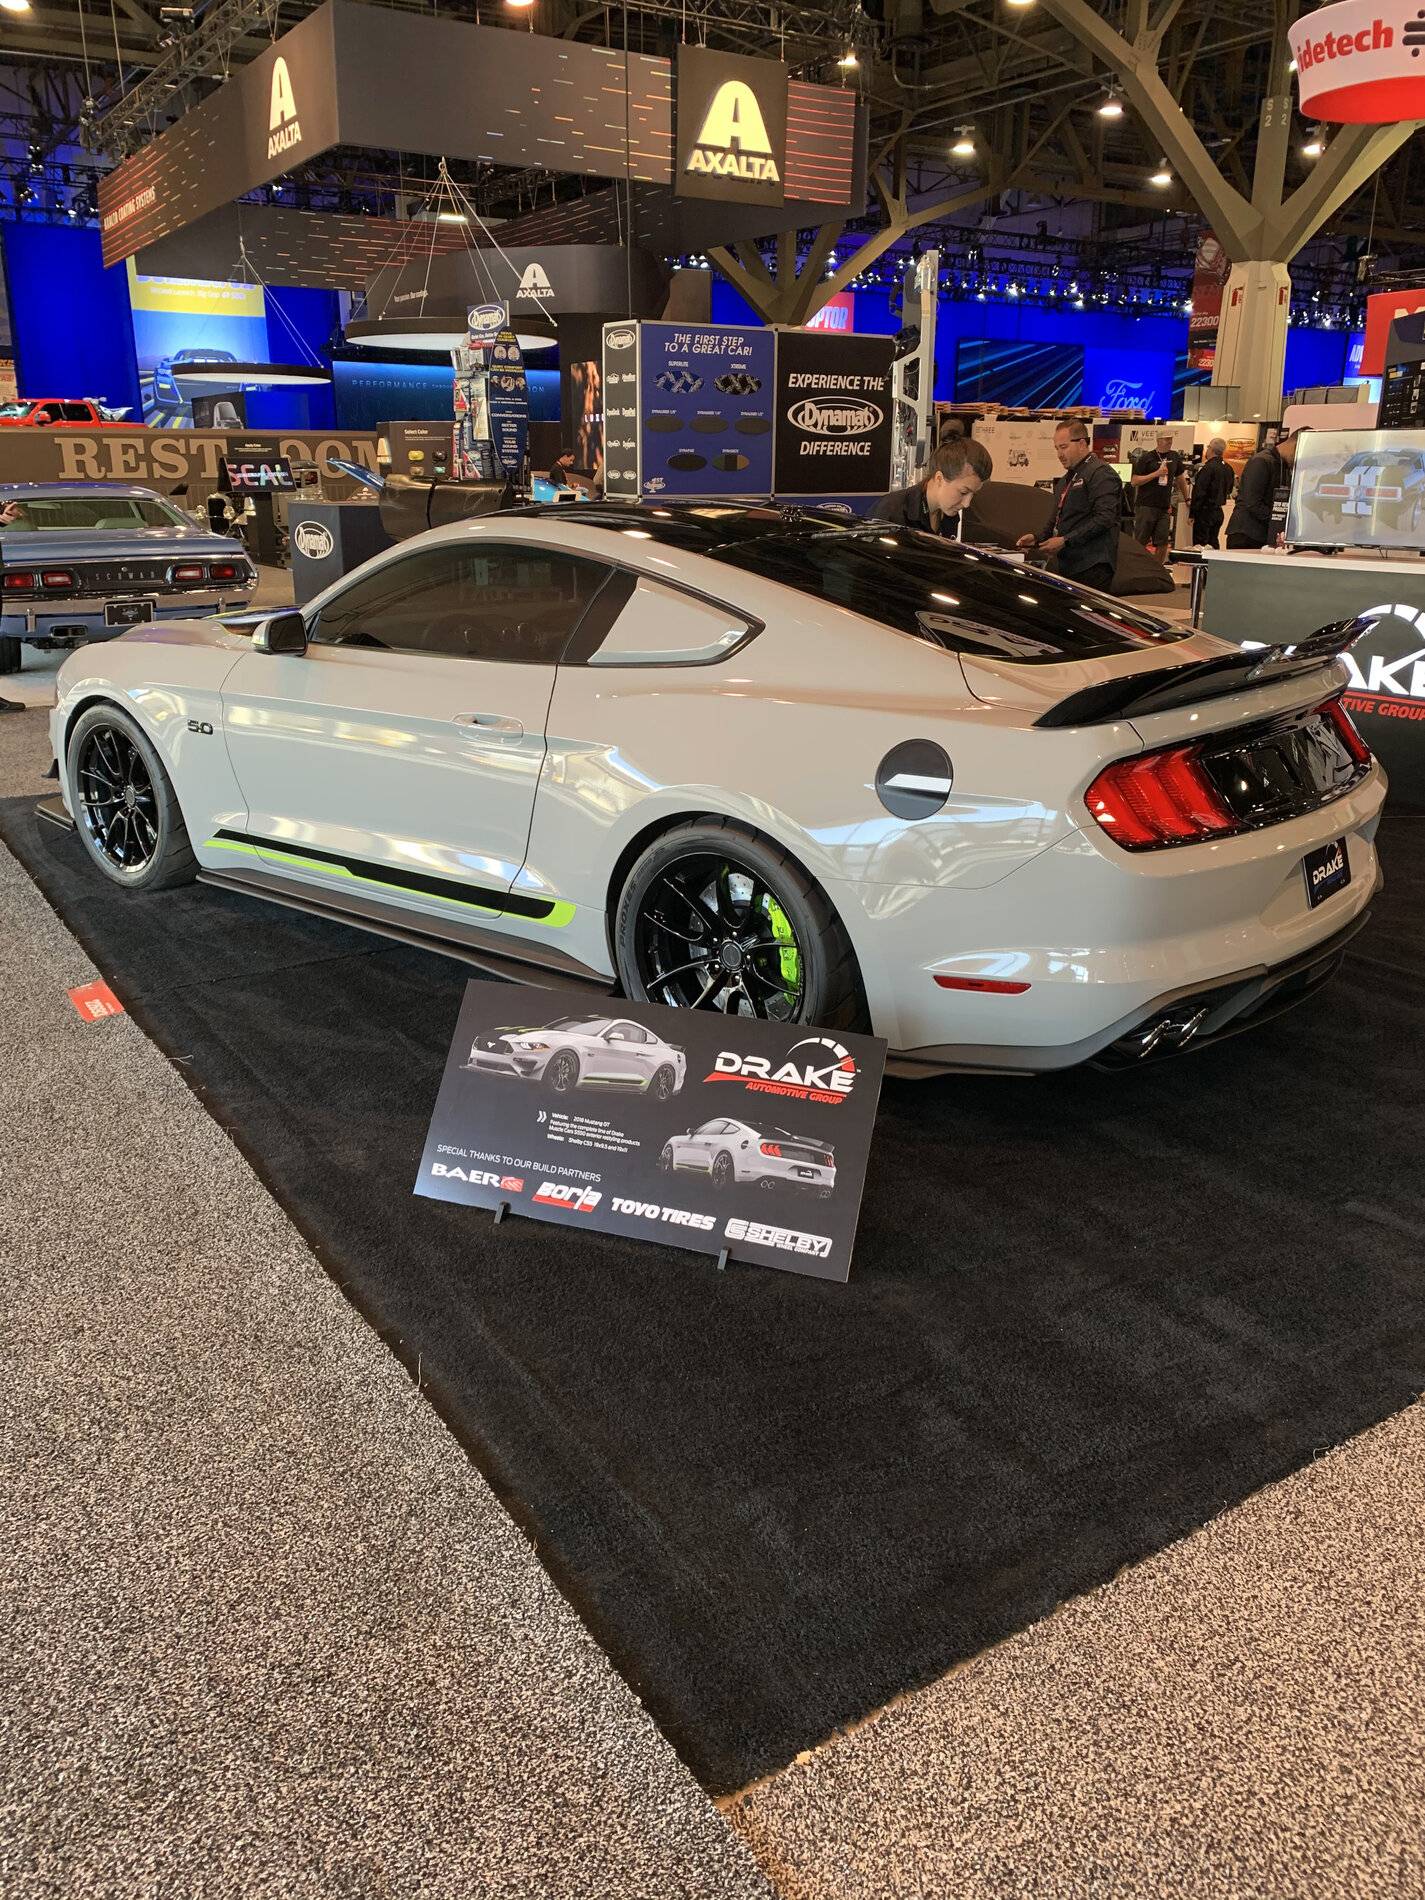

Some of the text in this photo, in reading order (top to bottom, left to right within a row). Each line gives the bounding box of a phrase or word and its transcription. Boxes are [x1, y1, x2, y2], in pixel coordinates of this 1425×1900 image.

[267, 120, 303, 160] AXALTA
[686, 148, 780, 182] AXALTA
[515, 287, 556, 299] AXALTA
[664, 342, 753, 357] TO A GREAT CAR!
[673, 333, 744, 347] THE FIRST STEP
[351, 378, 428, 390] PERFORMANCE
[787, 373, 886, 392] EXPERIENCE THE
[1099, 379, 1156, 415] Ford
[803, 401, 872, 432] Dynamat
[799, 441, 872, 456] DIFFERENCE
[1344, 699, 1374, 714] TIVE
[1312, 853, 1344, 886] DRAKE
[714, 1051, 856, 1093] DRAKE
[745, 1081, 844, 1105] AUTOMOTIVE GROUP
[577, 1125, 598, 1133] complete
[584, 1118, 603, 1128] Mustang
[568, 1137, 582, 1145] Shelby
[620, 1138, 641, 1147] products
[436, 1144, 602, 1182] SPECIAL THANKS TO OUR BUILD PARTNERS
[431, 1162, 501, 1188] BAER
[611, 1197, 717, 1231] TOYO TIRES
[746, 1226, 826, 1253] SHELBY
